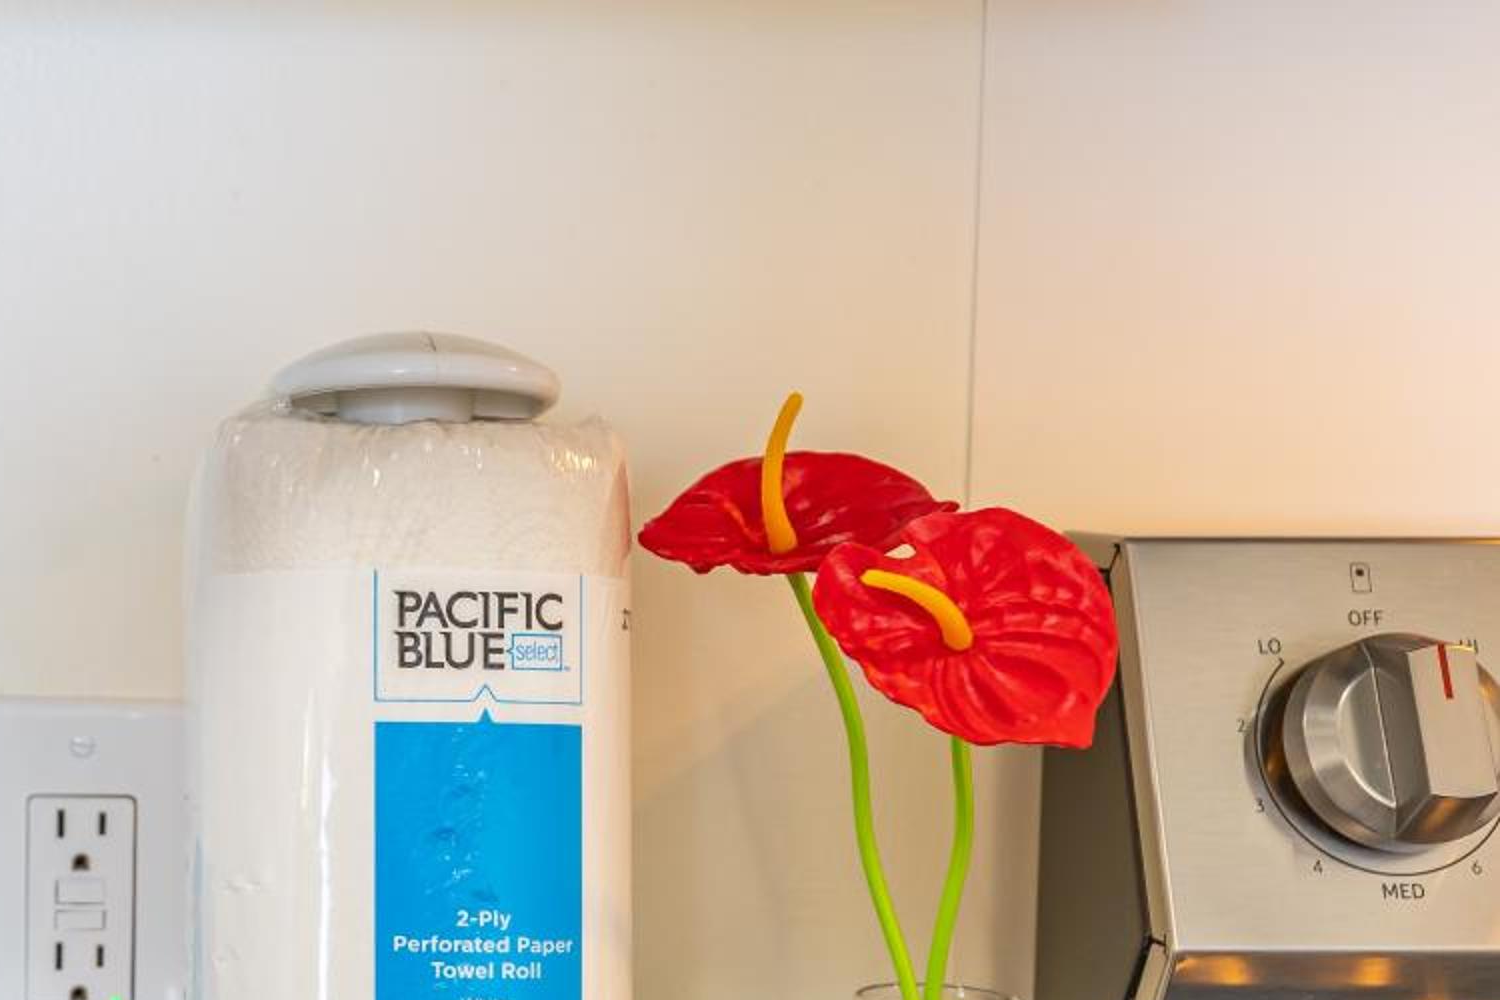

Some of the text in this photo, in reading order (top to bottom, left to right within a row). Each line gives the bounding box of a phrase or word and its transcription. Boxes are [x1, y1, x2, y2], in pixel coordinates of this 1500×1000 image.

[394, 590, 564, 631] PACIFIC
[1347, 610, 1384, 626] OFF
[395, 631, 558, 670] BLUE select
[1257, 639, 1282, 655] LO
[1471, 859, 1483, 875] 6
[1381, 883, 1426, 901] MED
[456, 909, 512, 932] 2-Ply
[392, 935, 574, 957] Perforated Paper
[431, 961, 543, 980] Towel Roll
